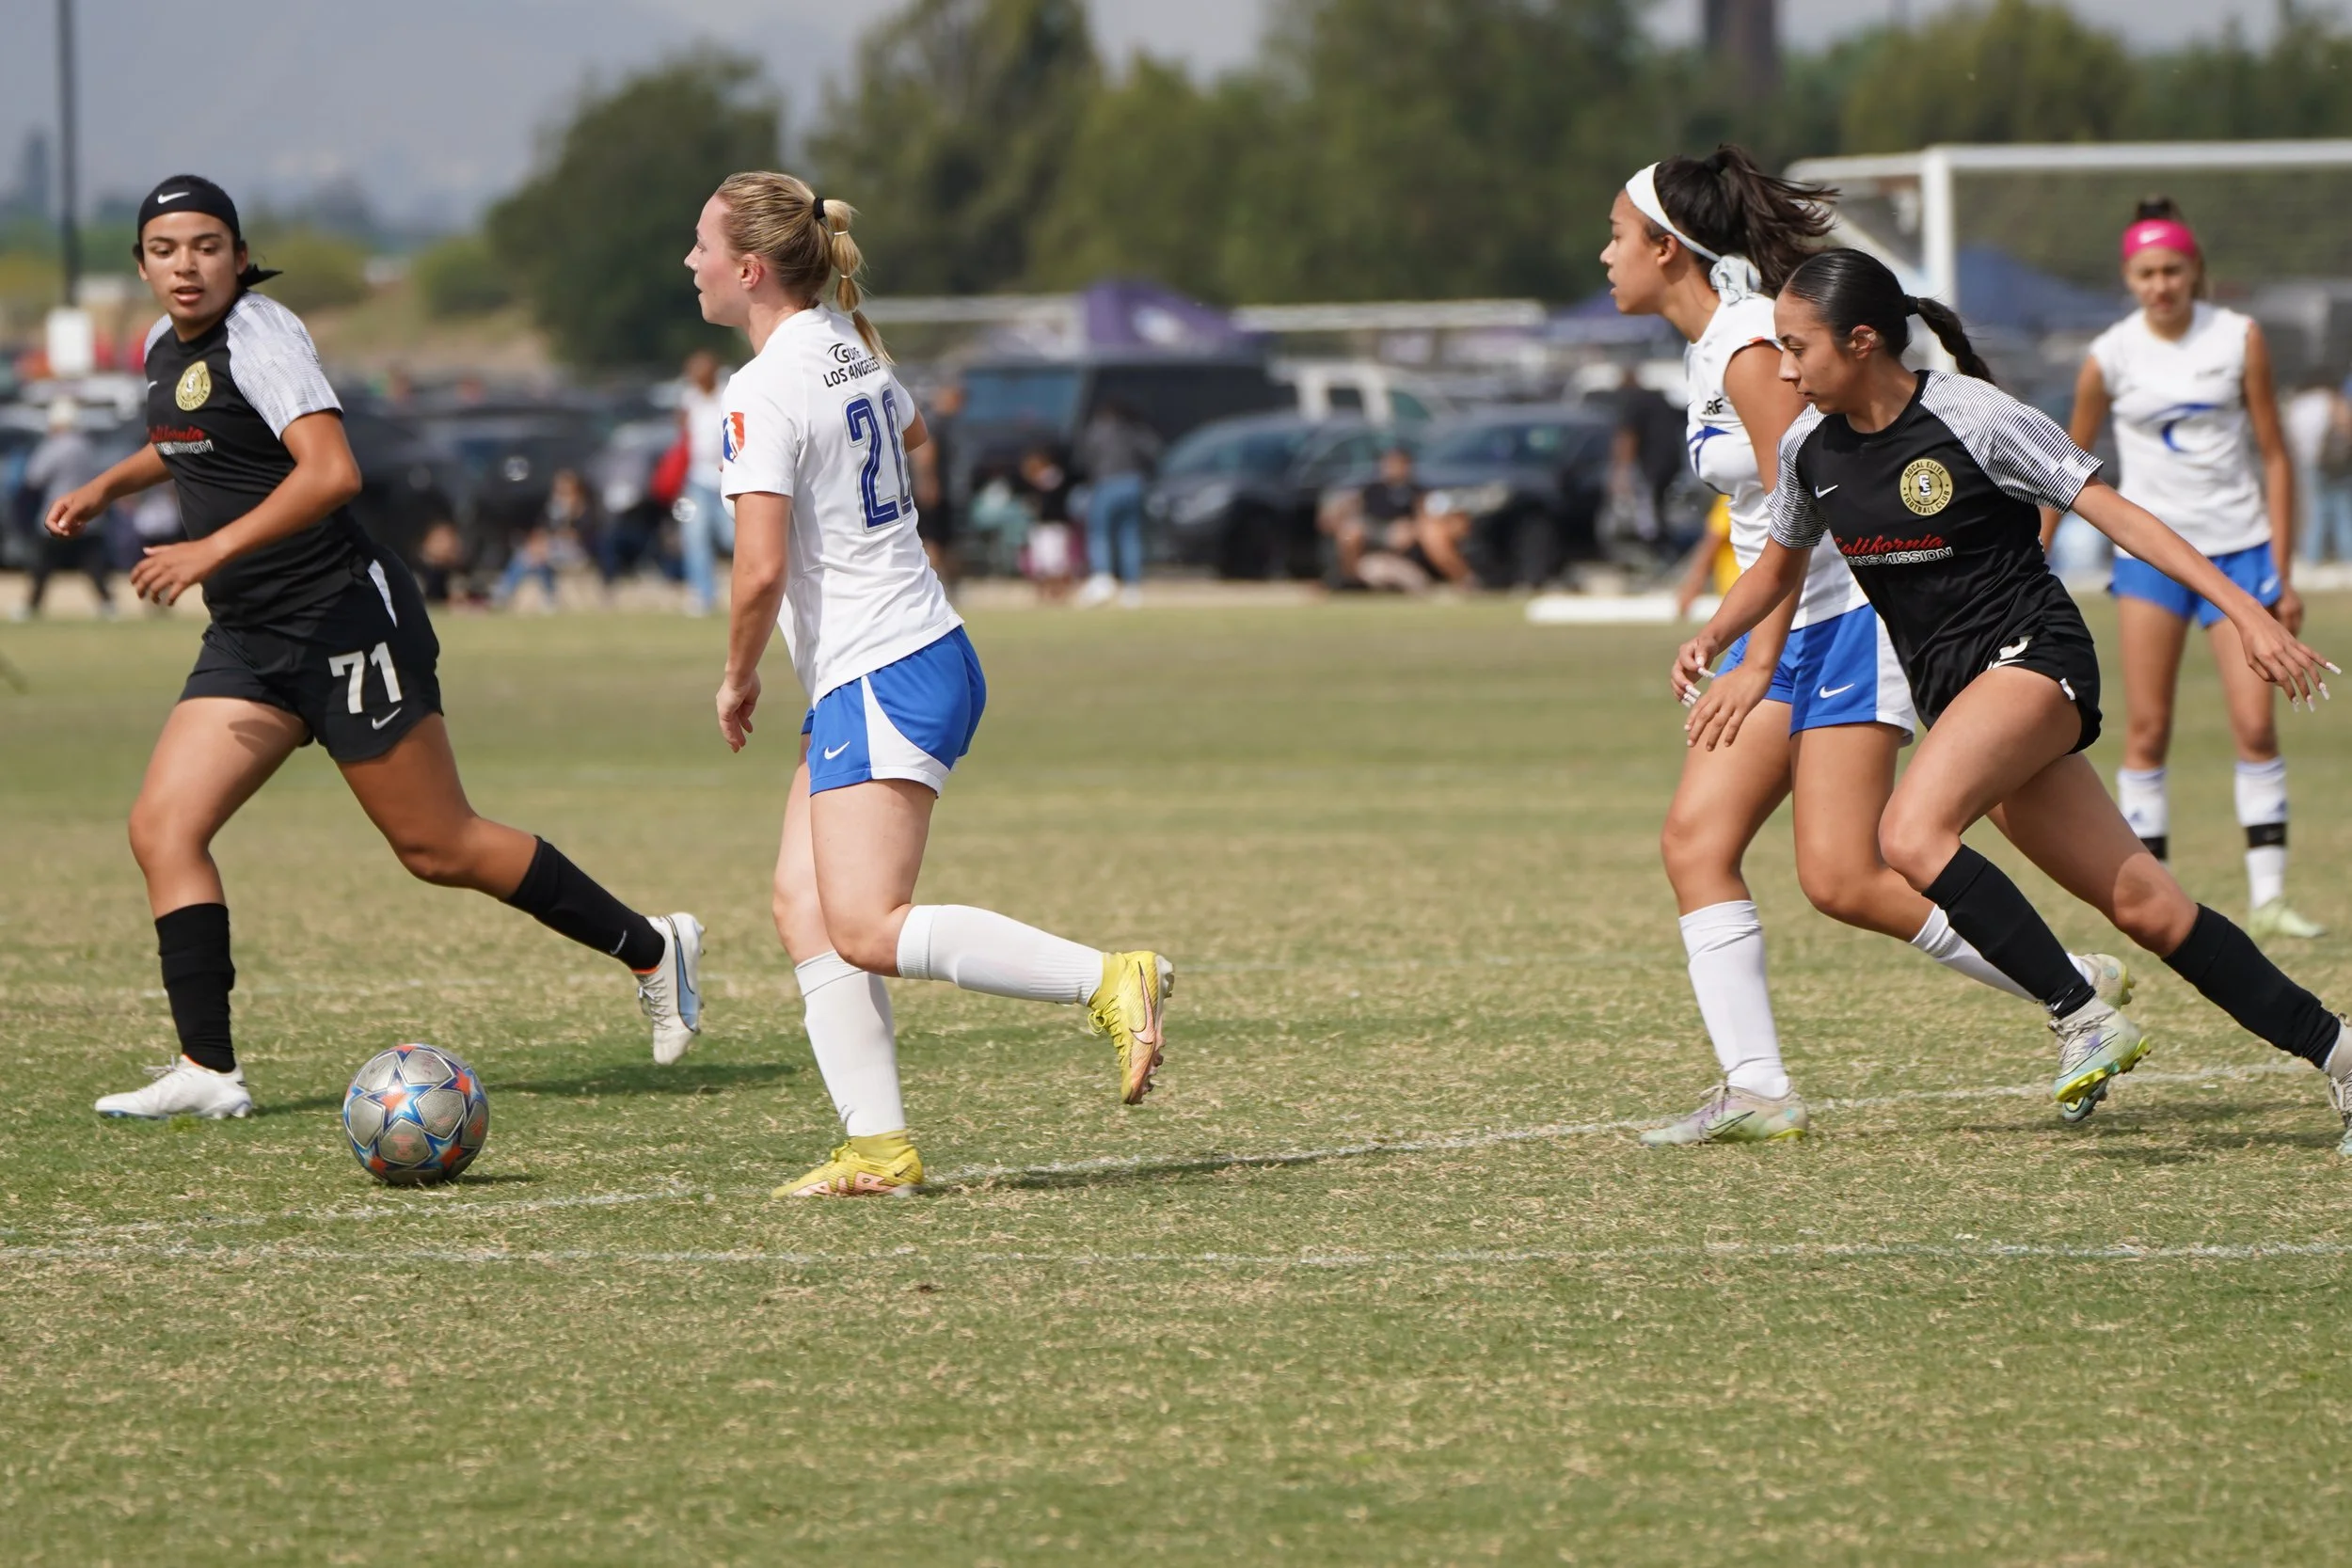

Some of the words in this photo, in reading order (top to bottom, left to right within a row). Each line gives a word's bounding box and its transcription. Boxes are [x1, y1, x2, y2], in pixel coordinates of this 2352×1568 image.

[823, 368, 849, 388] LOS
[849, 356, 881, 380] ANGELES
[1904, 462, 1925, 478] SOCAL
[1926, 461, 1946, 476] ELITE
[1903, 493, 1935, 514] FOOTBALL
[1935, 490, 1950, 510] CLUB
[327, 641, 403, 714] 71
